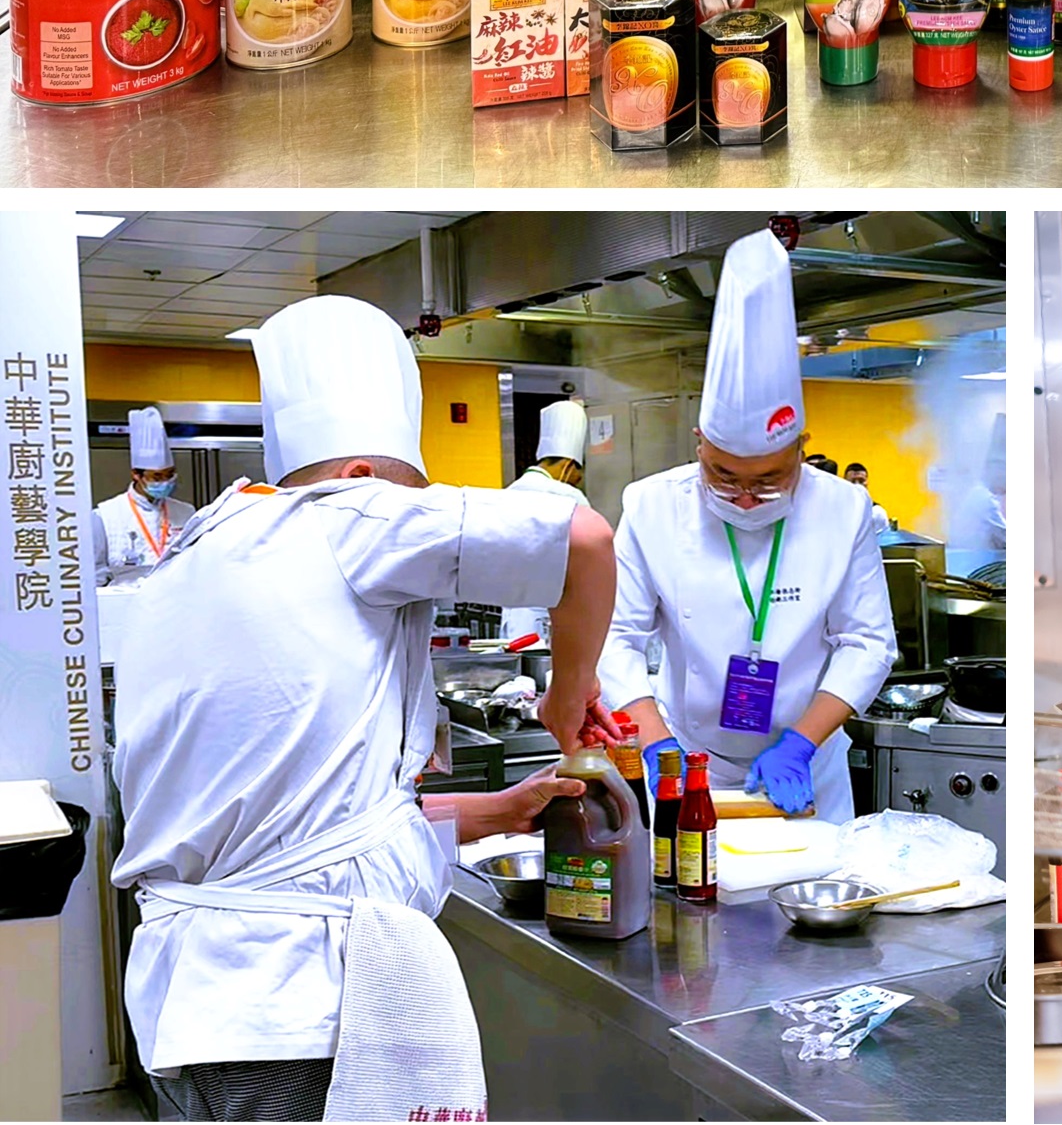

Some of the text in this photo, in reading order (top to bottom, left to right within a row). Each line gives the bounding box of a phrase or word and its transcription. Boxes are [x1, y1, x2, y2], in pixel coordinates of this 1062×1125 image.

[475, 11, 524, 38] 麻辣
[569, 7, 589, 31] 大
[1009, 13, 1036, 25] Premium
[1009, 23, 1047, 35] Oyster Sauce
[280, 47, 293, 57] NET
[294, 42, 319, 55] WEIGHT
[494, 27, 559, 66] 紅油
[111, 65, 184, 92] NET WEIGHT 3 kg
[520, 61, 555, 82] 辣醬
[4, 352, 53, 612] 中華廚藝學院
[47, 353, 92, 773] CHINESE CULINARY INSTITUTE
